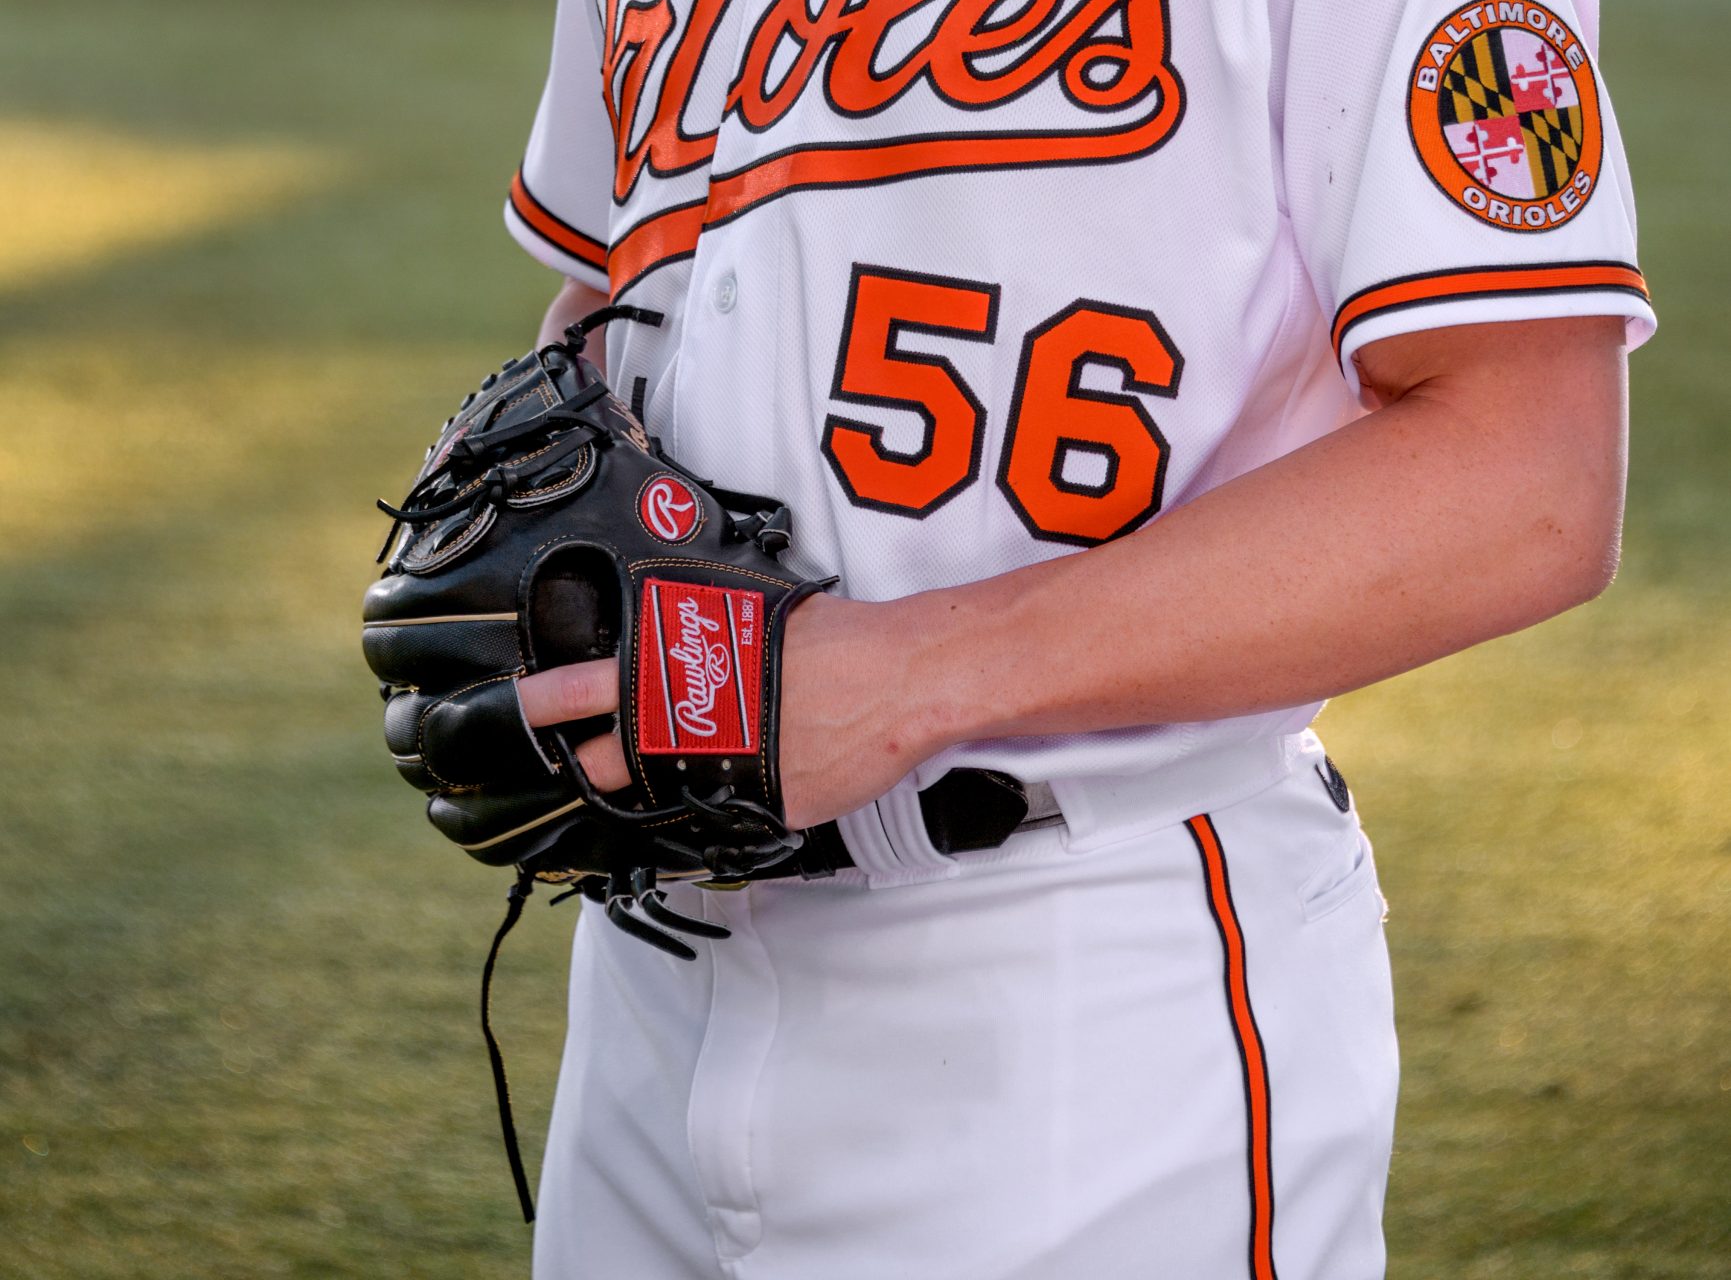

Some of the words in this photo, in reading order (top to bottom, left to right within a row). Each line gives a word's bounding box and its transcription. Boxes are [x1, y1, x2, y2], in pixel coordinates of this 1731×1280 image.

[1416, 1, 1585, 93] BALTIMORE
[1462, 169, 1591, 227] ORIOLES
[820, 262, 1186, 548] 56
[741, 599, 754, 622] 1887
[670, 596, 720, 737] Rawlings
